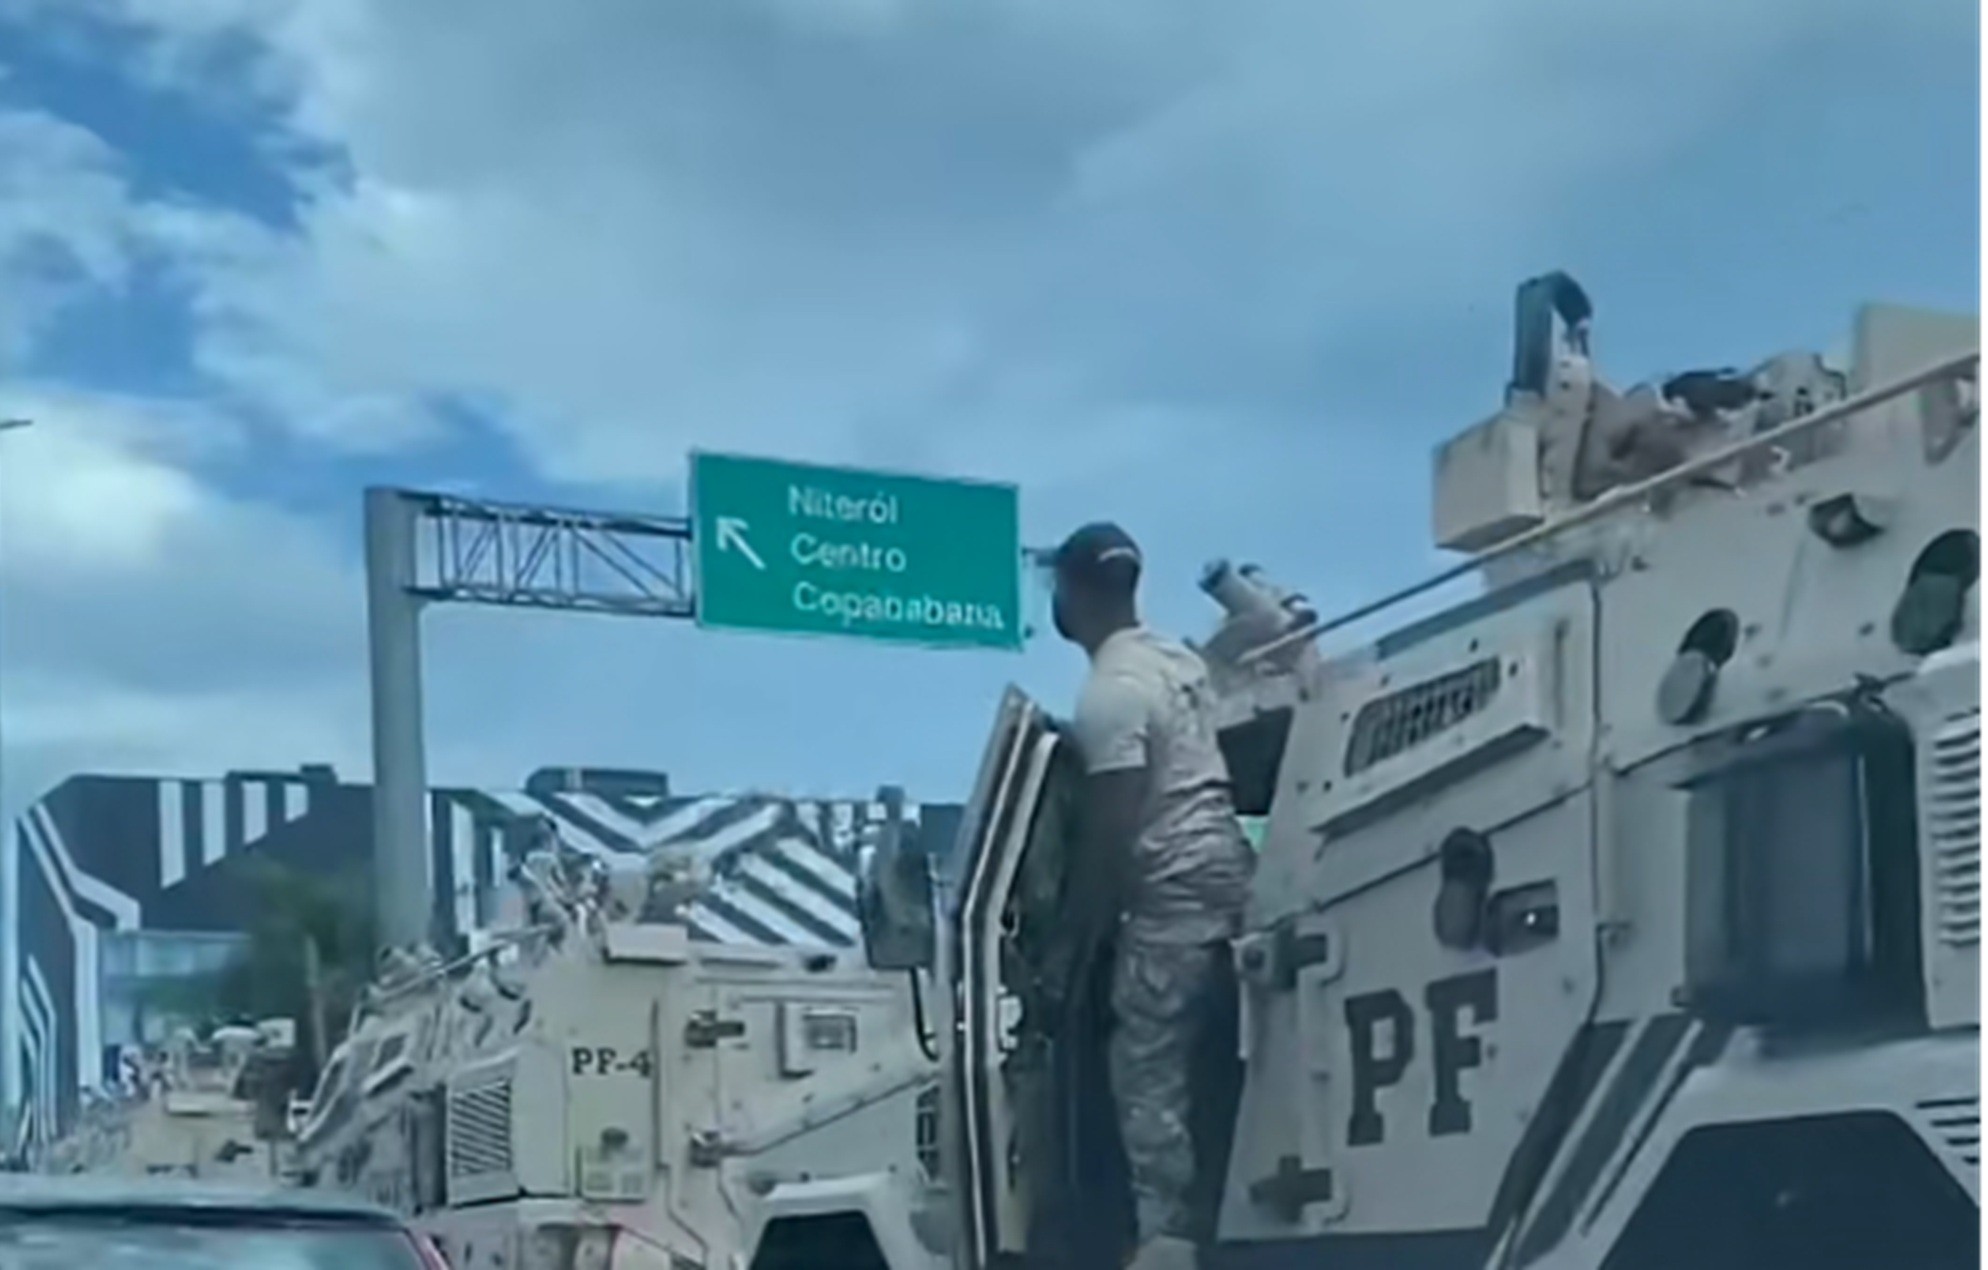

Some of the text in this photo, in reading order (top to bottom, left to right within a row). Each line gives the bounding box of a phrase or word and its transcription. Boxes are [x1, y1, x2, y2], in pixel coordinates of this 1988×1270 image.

[790, 532, 906, 572] Centro
[571, 1047, 652, 1078] PF-4
[1344, 966, 1498, 1147] PF
